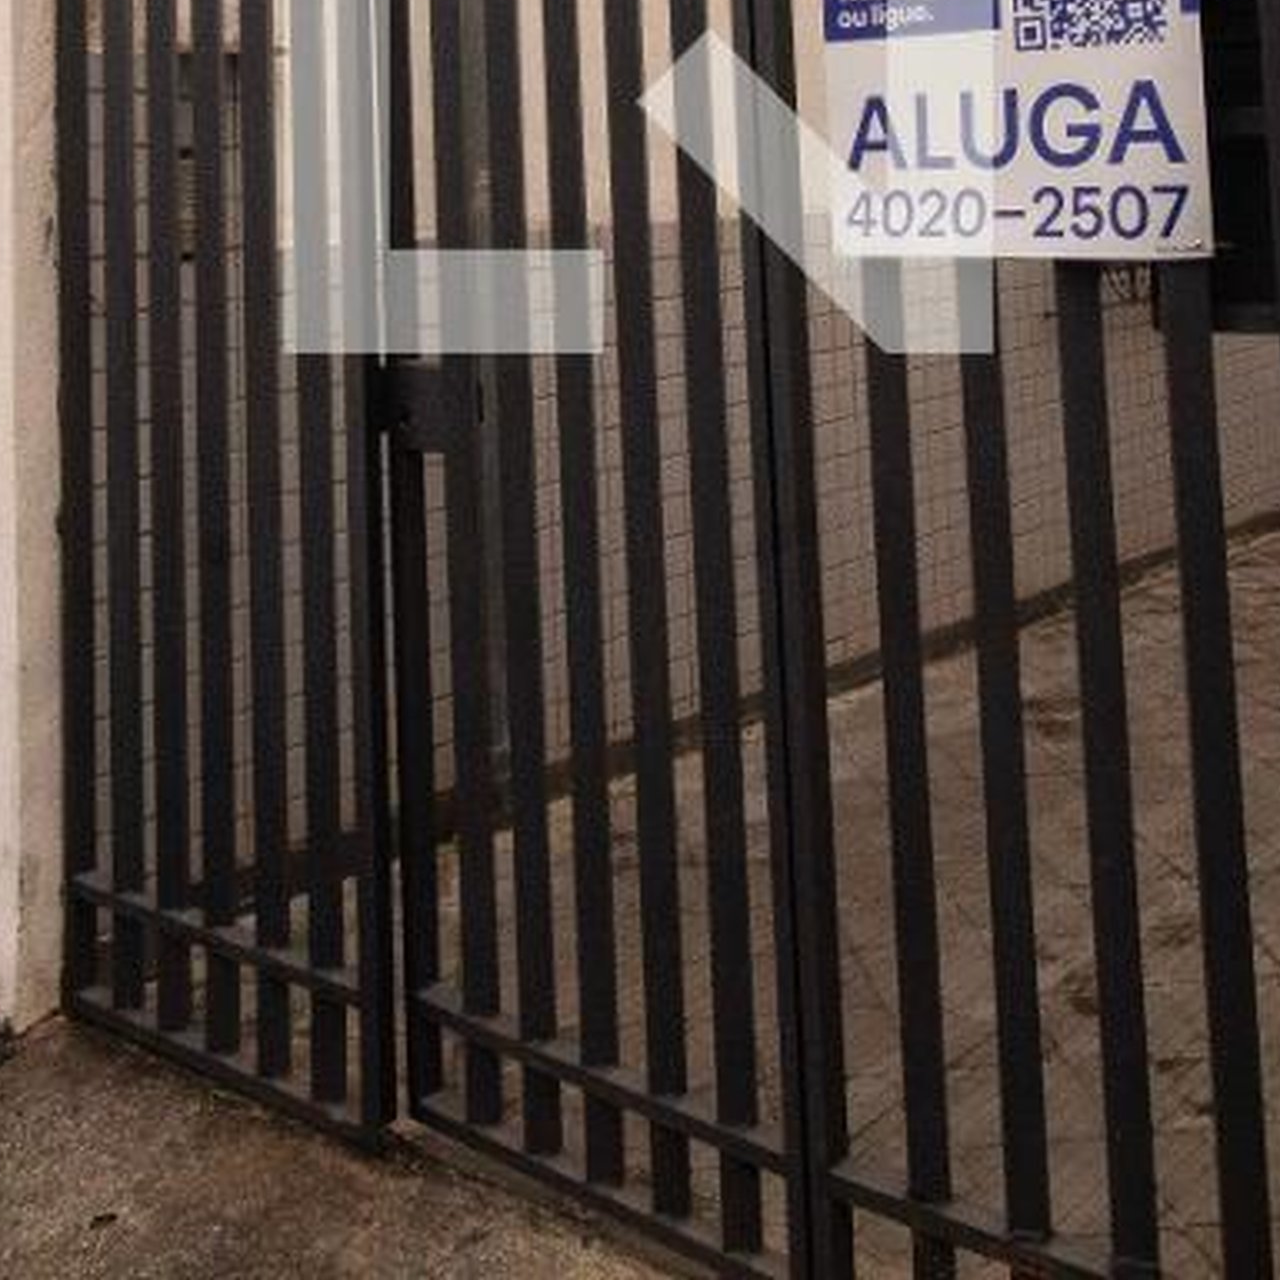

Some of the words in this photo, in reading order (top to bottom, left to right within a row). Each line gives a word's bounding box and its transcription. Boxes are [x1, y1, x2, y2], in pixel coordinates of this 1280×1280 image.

[838, 10, 868, 28] ou
[847, 79, 1187, 171] ALUGA
[847, 185, 1189, 240] 4020-2507
